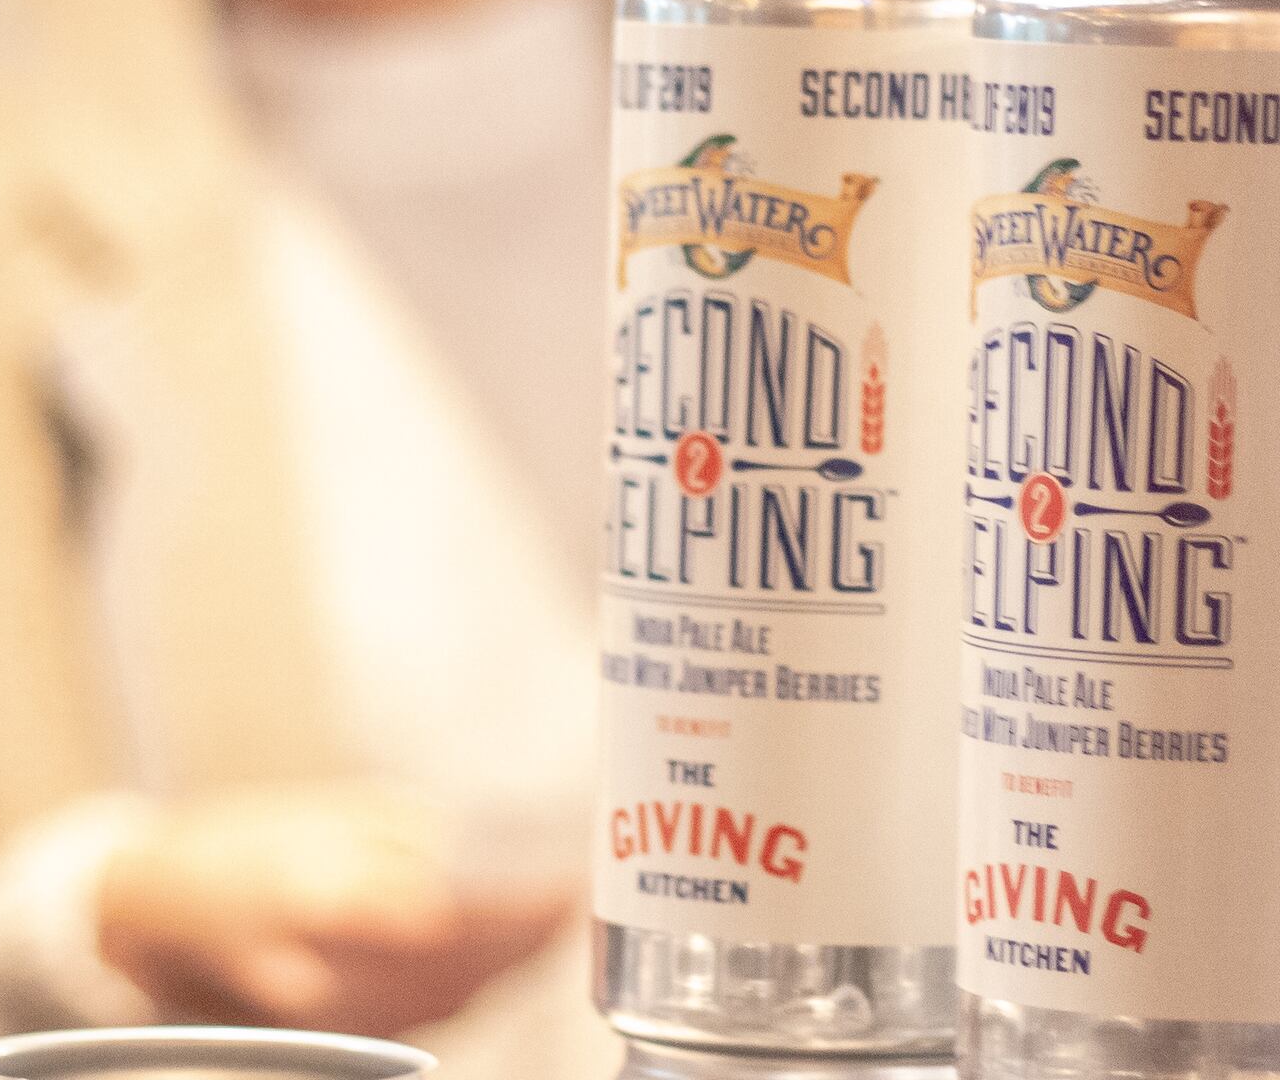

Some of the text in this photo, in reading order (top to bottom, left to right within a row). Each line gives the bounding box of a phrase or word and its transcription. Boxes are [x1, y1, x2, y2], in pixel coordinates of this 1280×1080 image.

[801, 69, 929, 119] SECOND
[1004, 84, 1055, 136] 2019
[729, 618, 771, 656] ALE
[775, 664, 882, 704] BERRIES
[1073, 671, 1114, 711] ALE
[1021, 712, 1110, 757] JUNIPER
[1118, 721, 1229, 764] BERRIES
[666, 758, 717, 788] THE
[610, 799, 810, 885] GIVING
[1011, 818, 1059, 851] THE
[636, 869, 750, 905] KITCHEN
[963, 862, 1153, 954] GIVING
[984, 934, 1093, 976] KITCHEN
